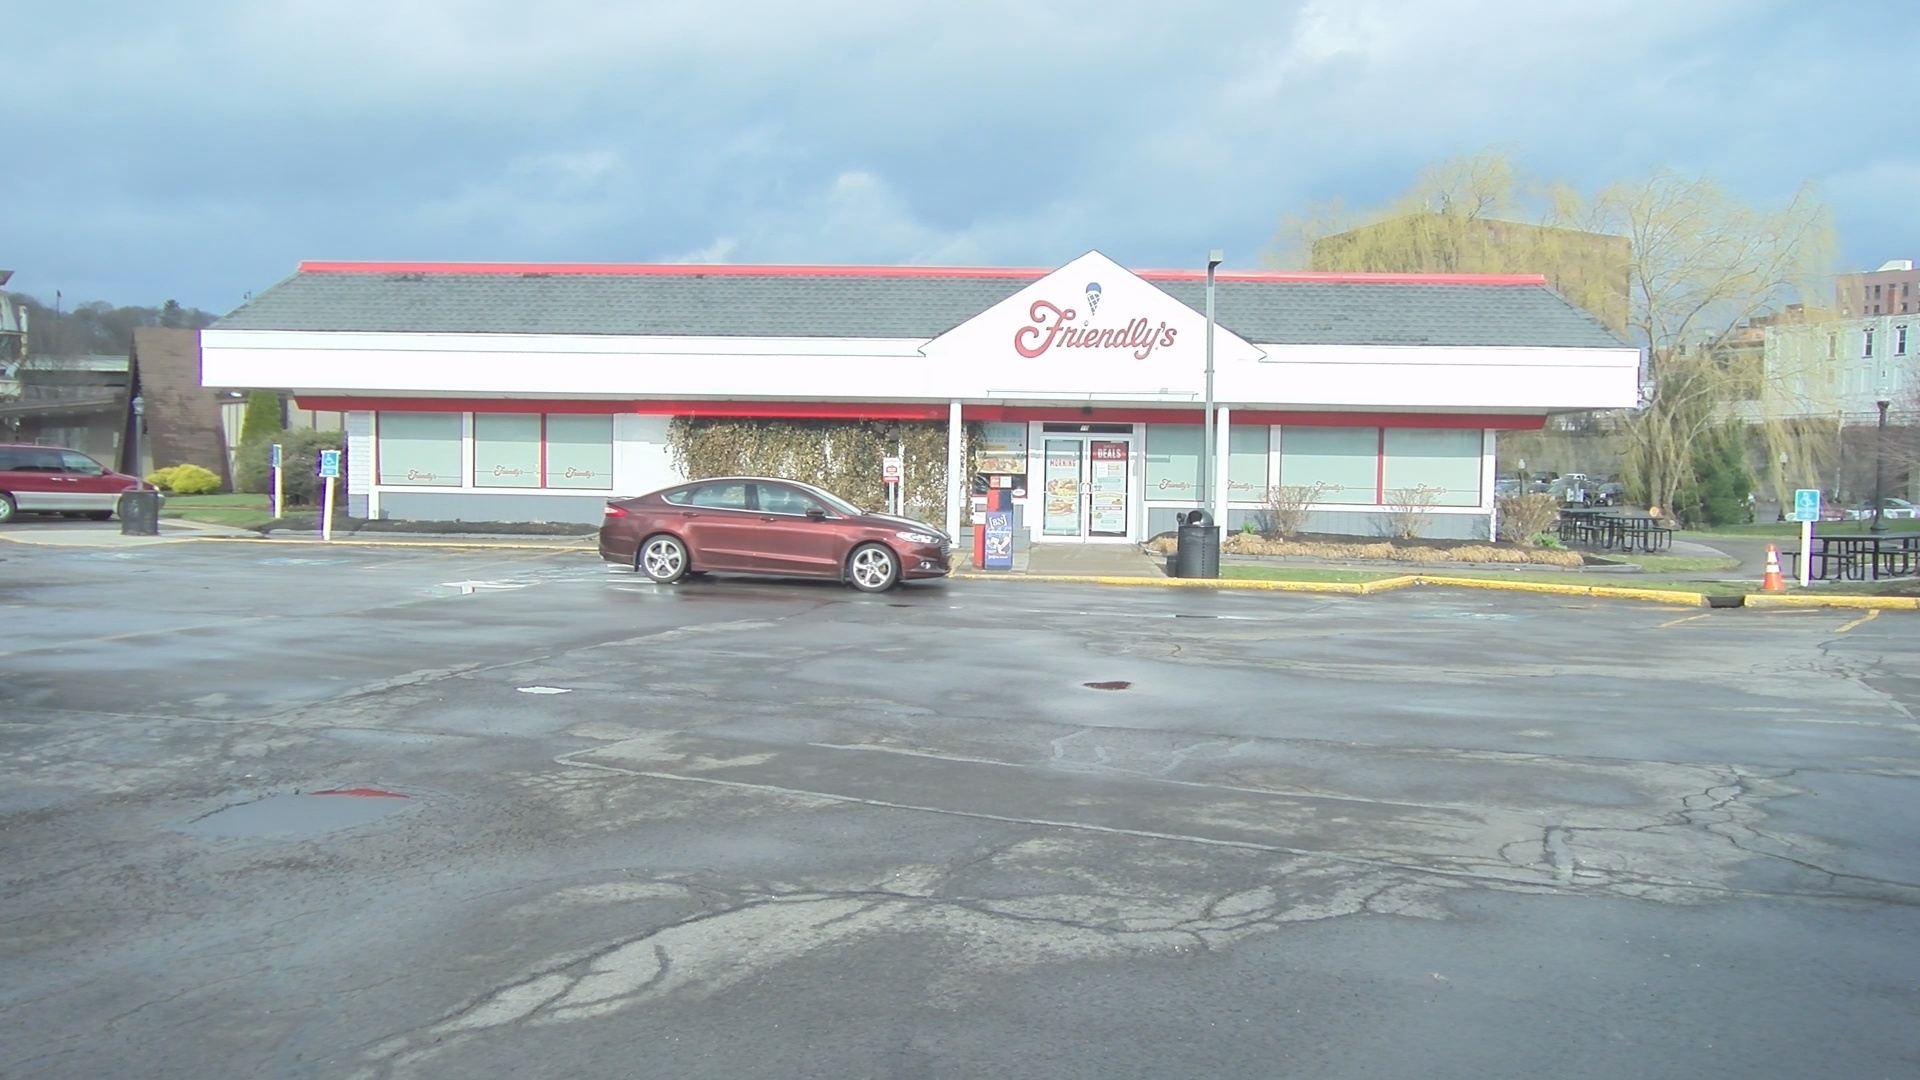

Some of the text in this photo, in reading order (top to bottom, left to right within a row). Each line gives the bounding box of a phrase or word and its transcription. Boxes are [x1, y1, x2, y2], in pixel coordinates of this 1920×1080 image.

[1014, 300, 1178, 360] Friendly's
[1097, 448, 1121, 459] DEALS
[1049, 459, 1076, 467] MORNING
